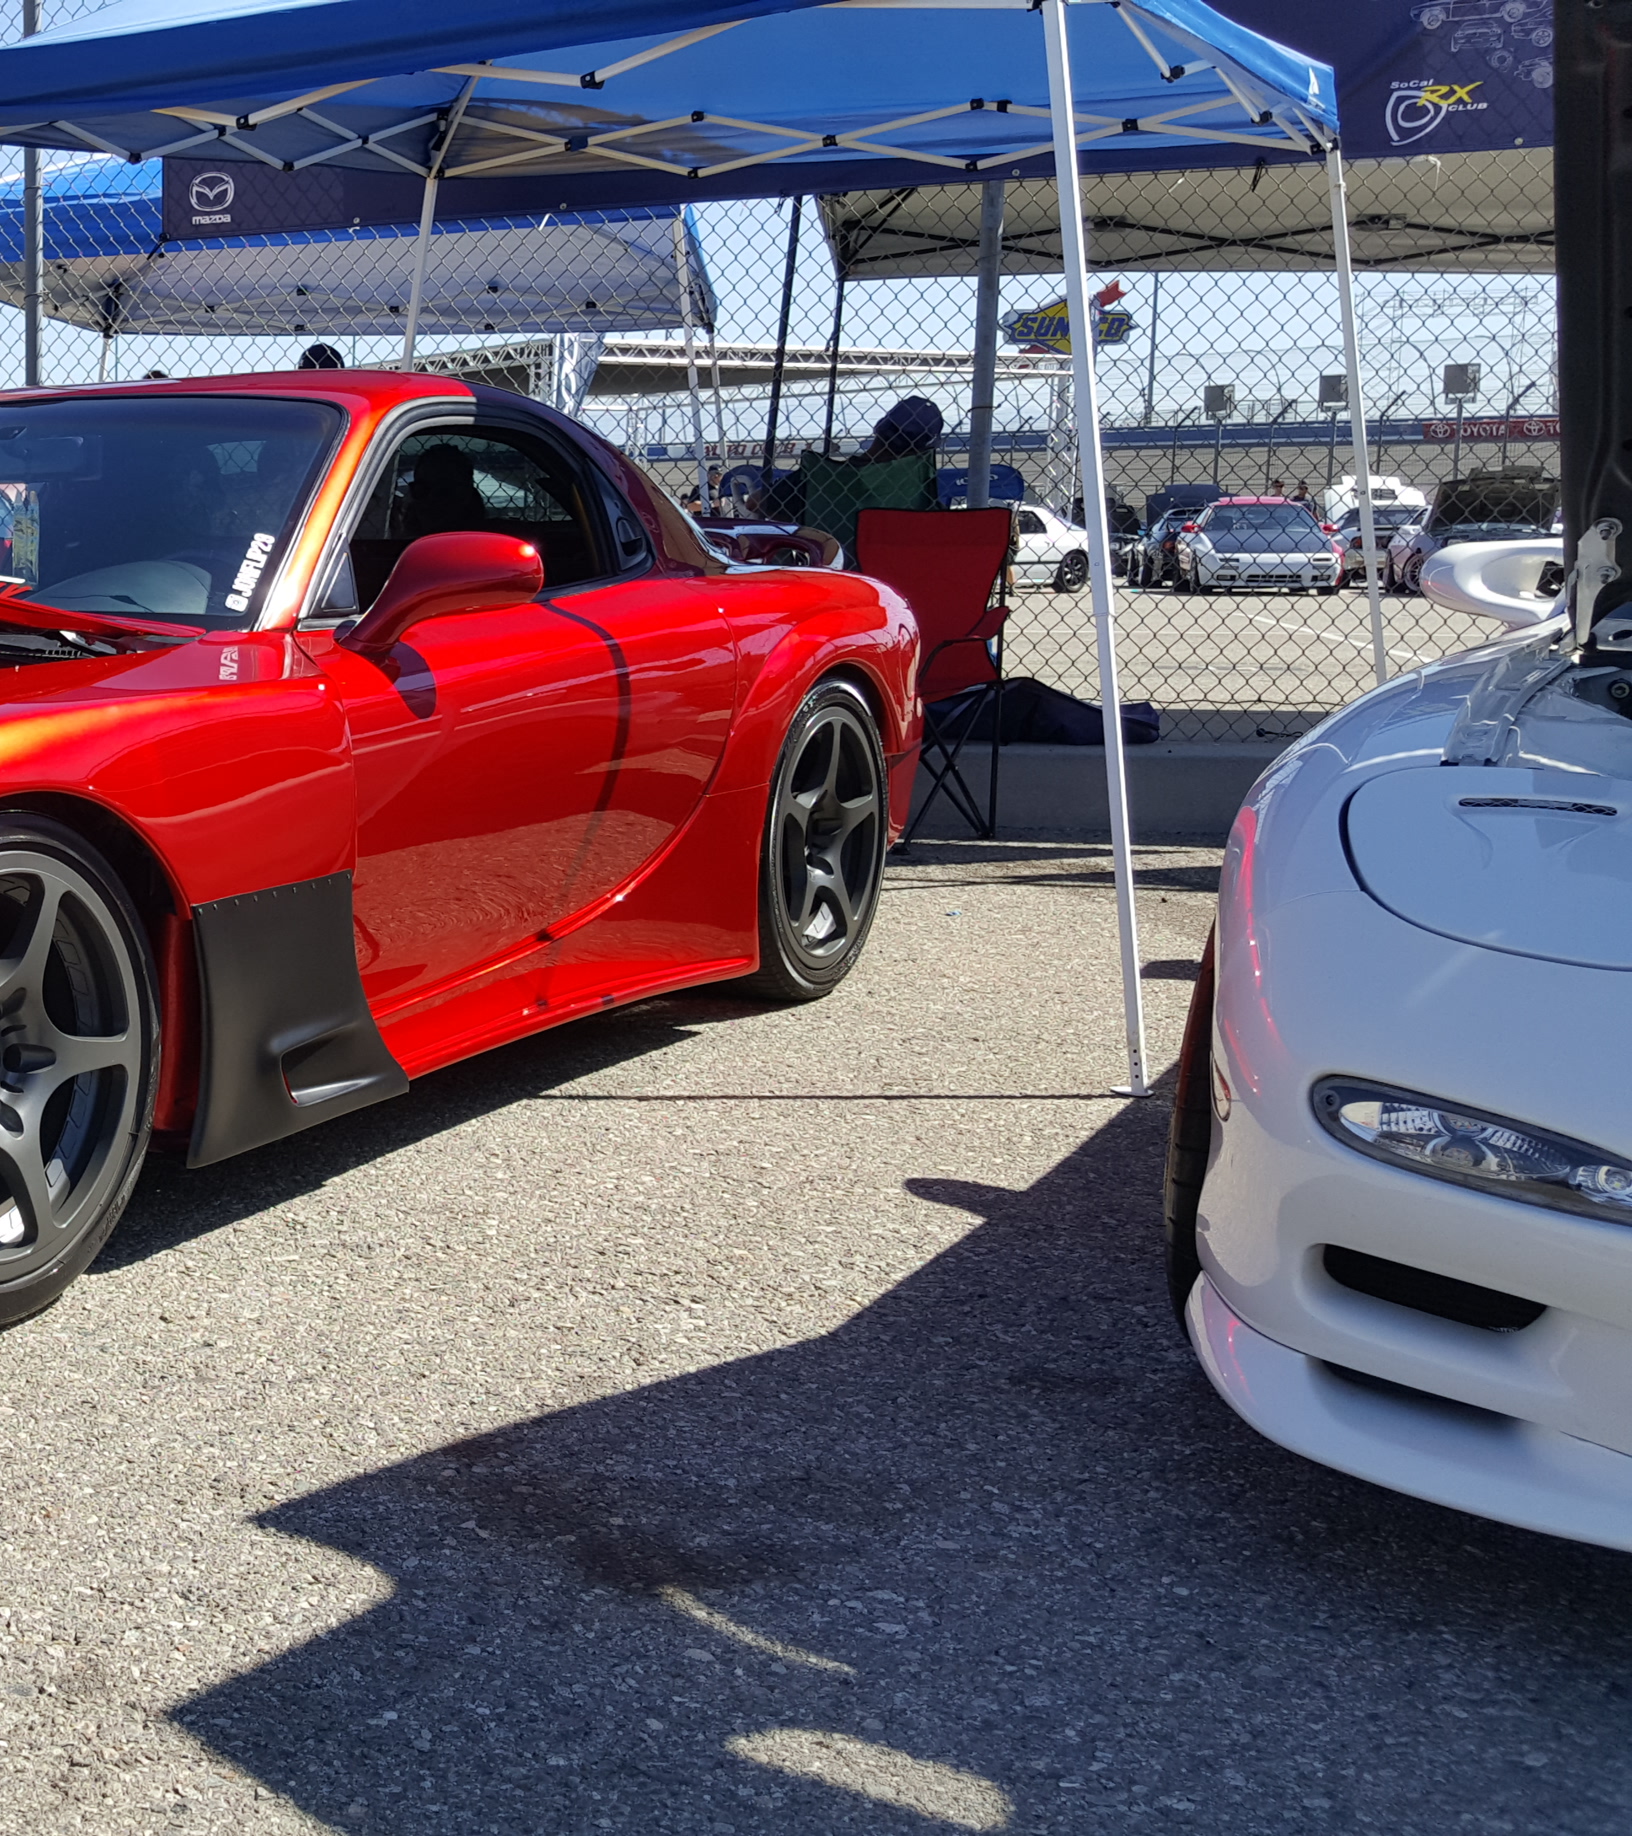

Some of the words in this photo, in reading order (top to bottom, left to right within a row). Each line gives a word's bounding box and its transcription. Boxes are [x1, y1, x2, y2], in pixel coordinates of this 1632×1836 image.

[1390, 79, 1434, 89] SoCal
[1416, 81, 1484, 106] RX
[1447, 102, 1489, 112] CLUB
[1016, 315, 1125, 339] SUNO
